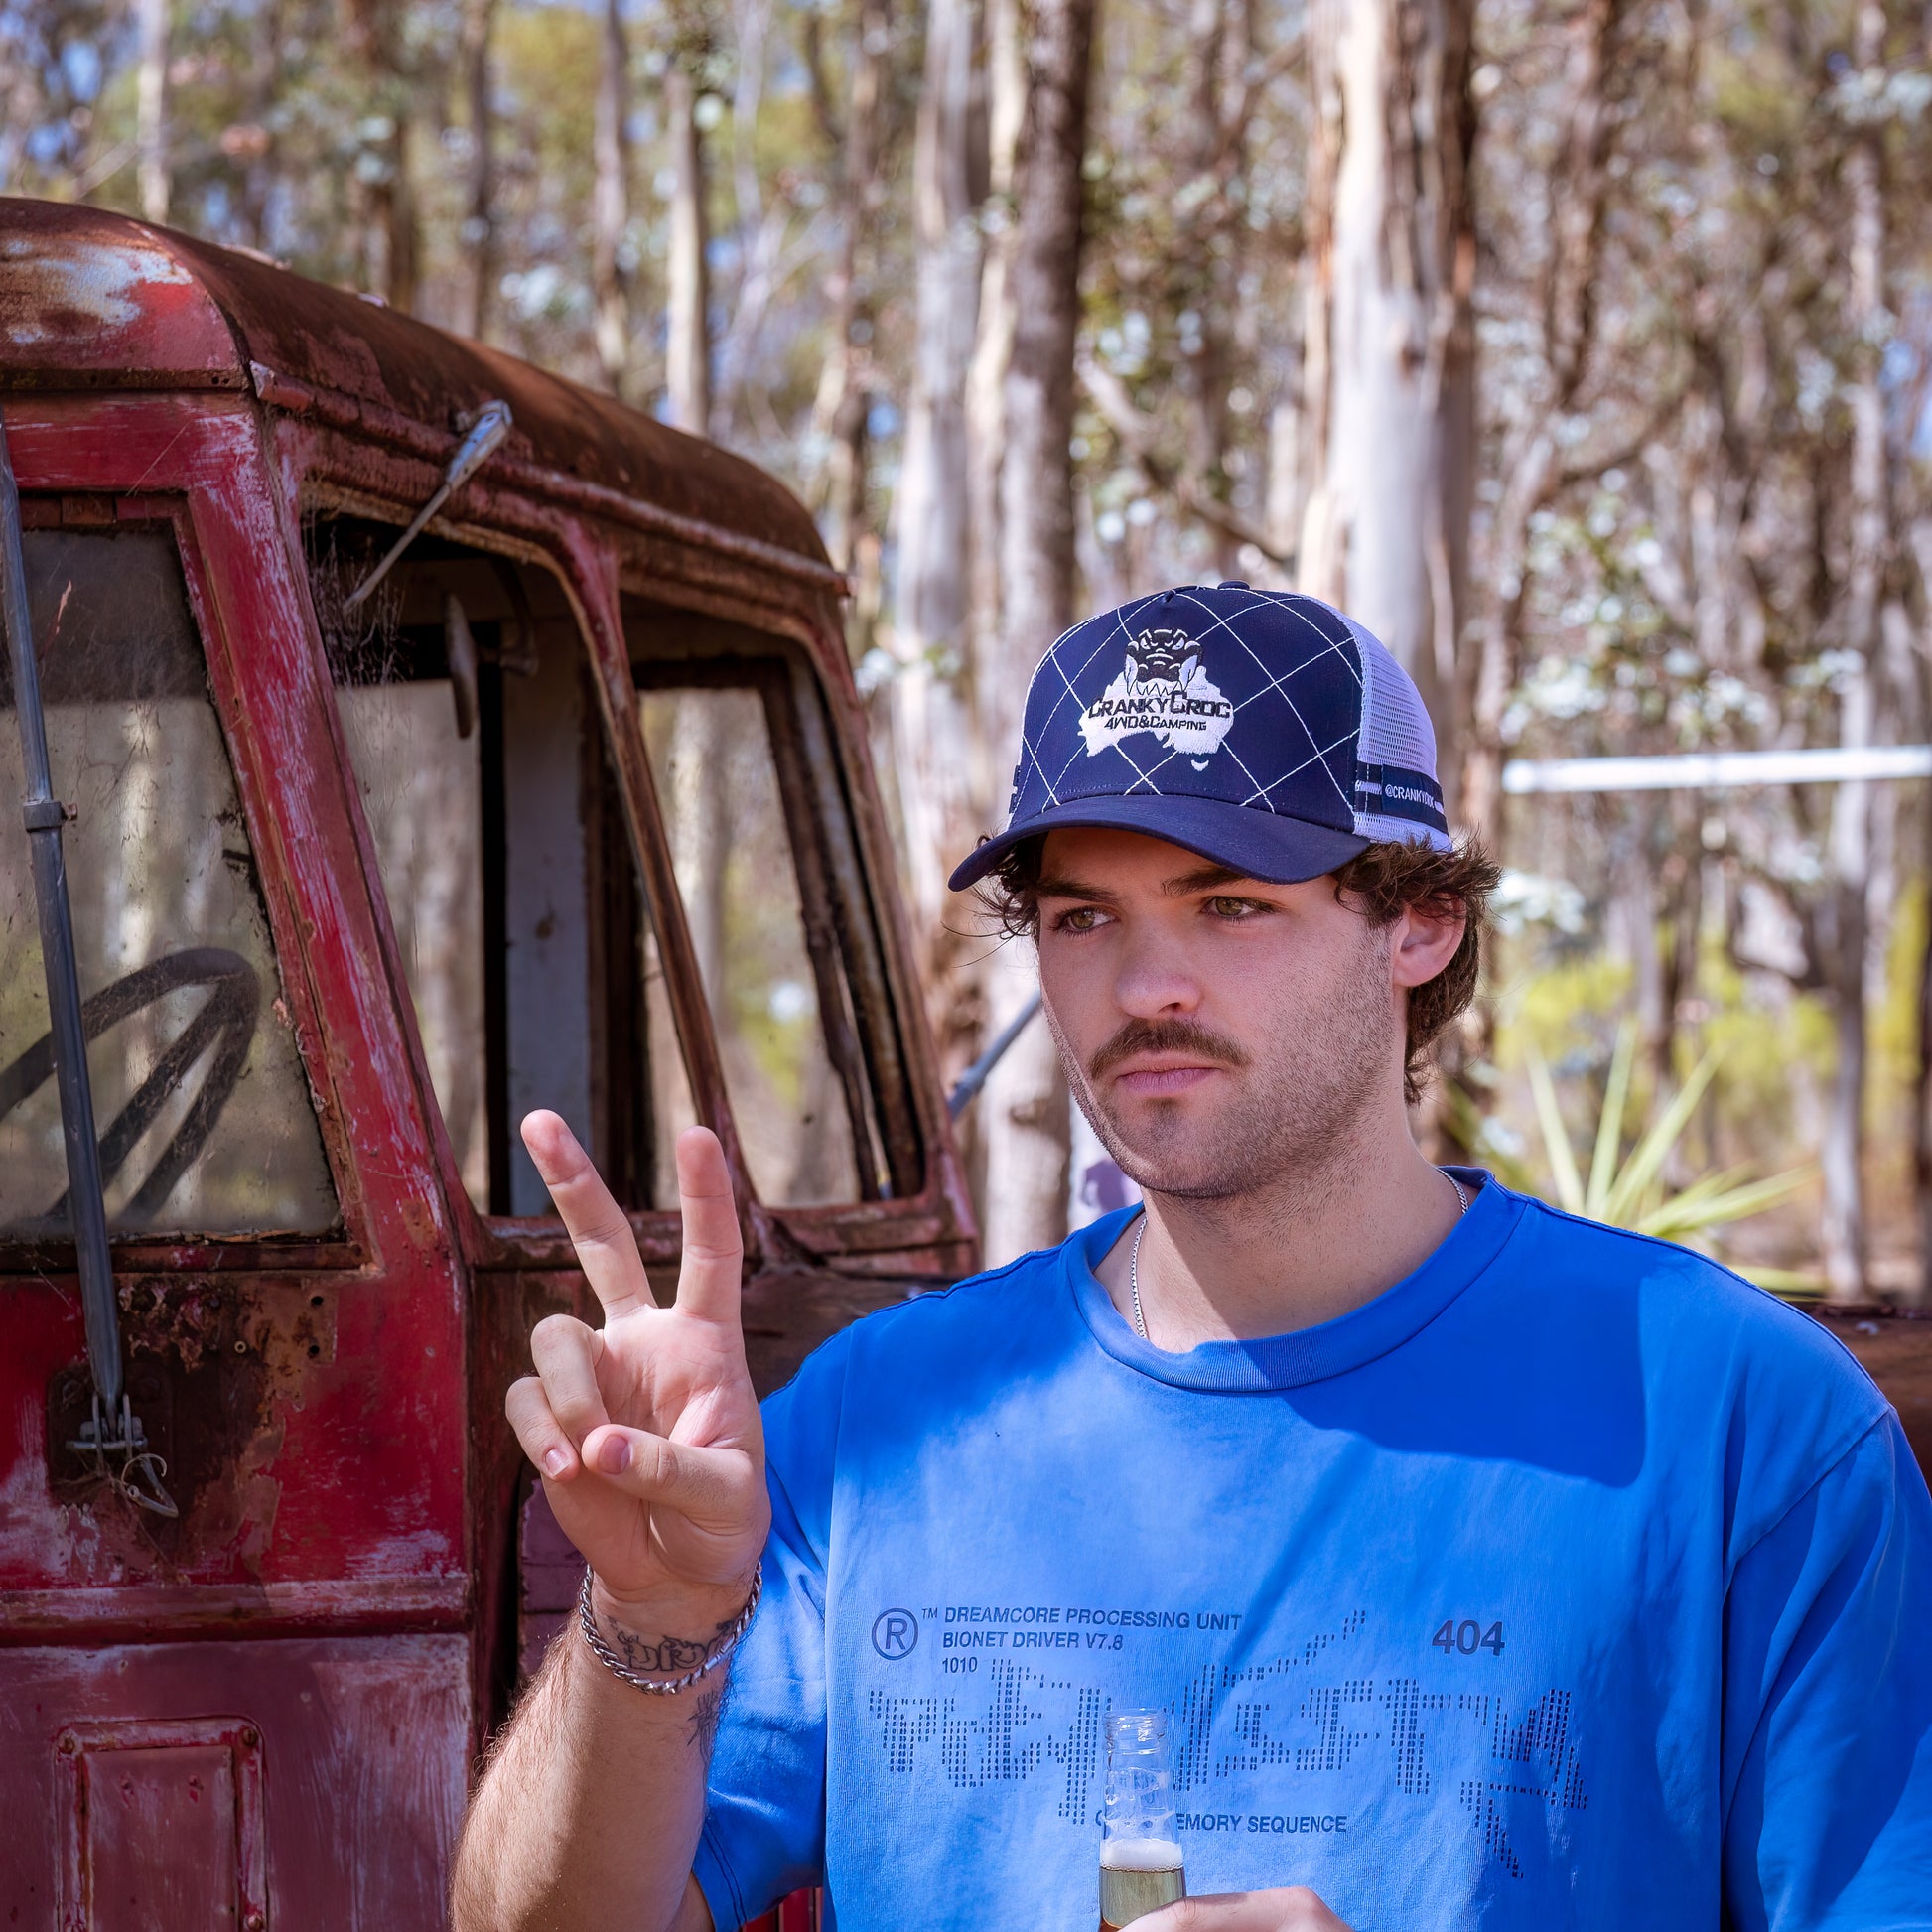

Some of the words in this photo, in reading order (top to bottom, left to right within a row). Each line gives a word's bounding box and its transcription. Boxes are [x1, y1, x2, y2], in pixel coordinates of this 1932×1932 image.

[944, 1606, 1061, 1624] DREAMCORE
[1066, 1607, 1190, 1629] PROCESSING
[1196, 1613, 1242, 1631] UNIT
[942, 1631, 1009, 1648] BIONET
[1012, 1631, 1080, 1649] DRIVER
[1086, 1632, 1124, 1651] V7.8
[1431, 1619, 1506, 1656] 404
[942, 1656, 978, 1674] 1010
[1175, 1812, 1242, 1833] EMORY
[1247, 1815, 1348, 1834] SEQUENCE
